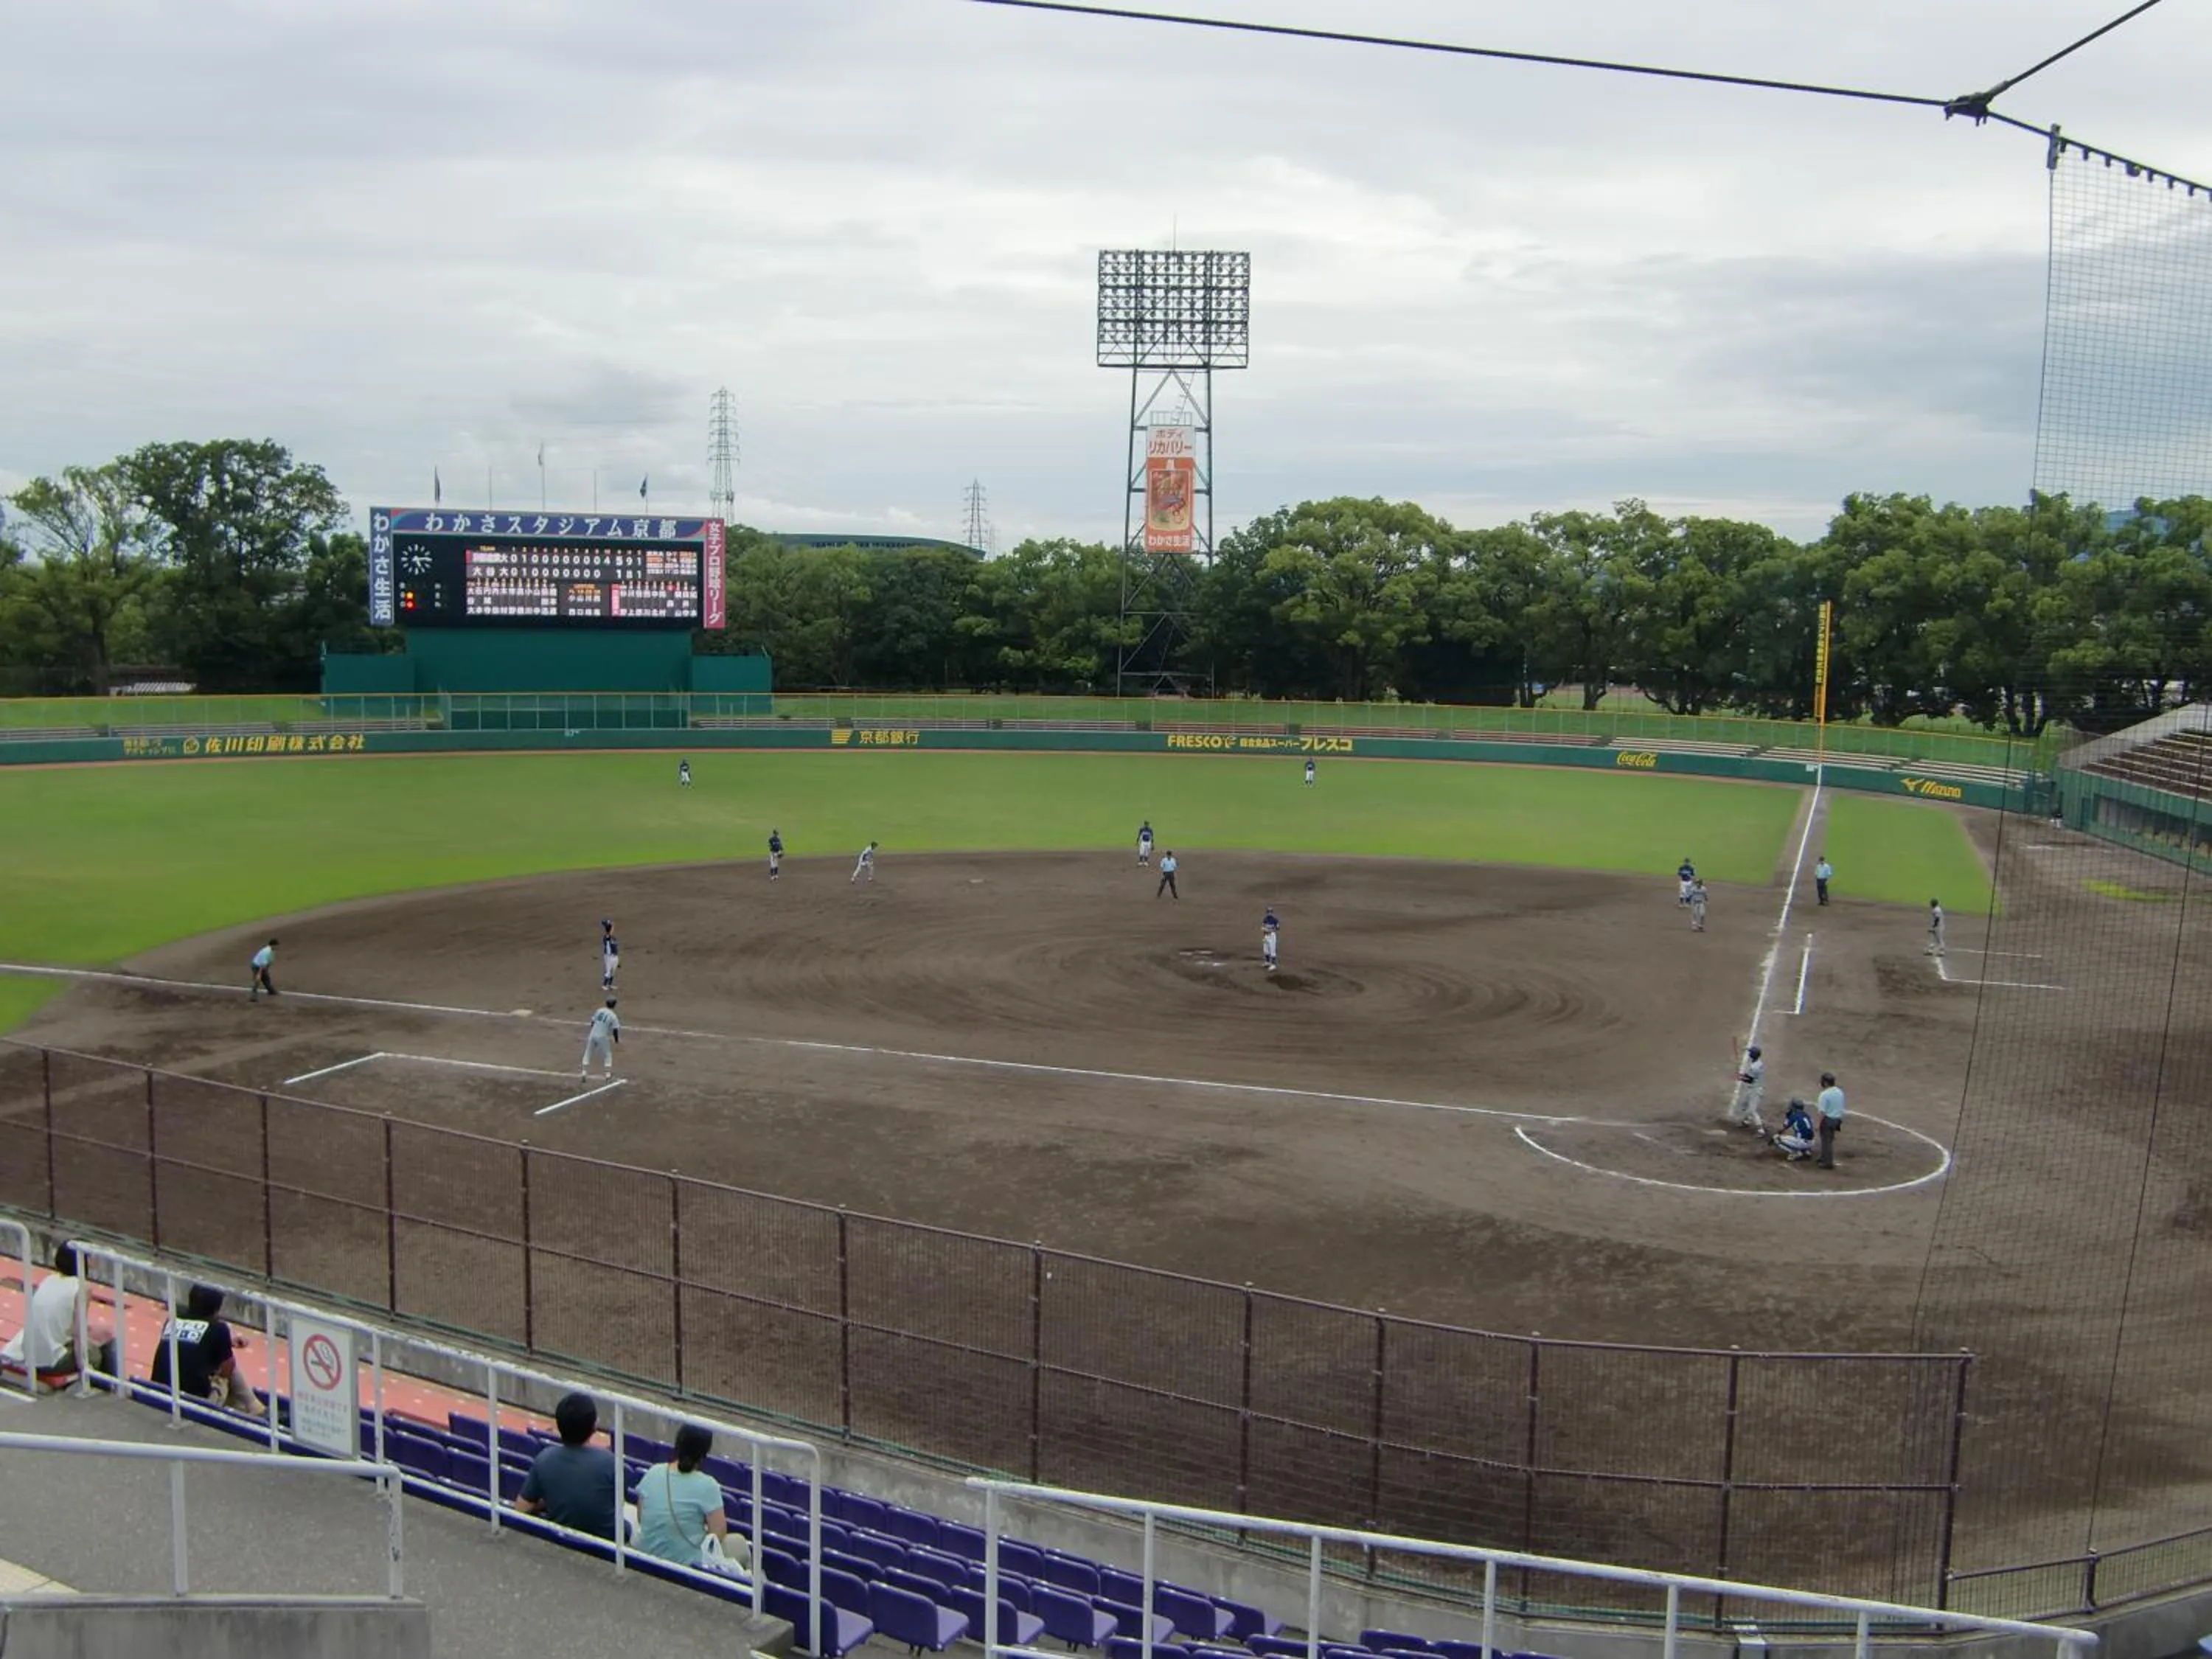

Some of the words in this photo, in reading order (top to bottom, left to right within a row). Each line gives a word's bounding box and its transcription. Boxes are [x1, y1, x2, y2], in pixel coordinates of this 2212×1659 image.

[1155, 428, 1183, 439] ボディ
[1150, 441, 1192, 454] リカバリー
[425, 513, 677, 539] わかさスタジアム京都
[374, 512, 392, 620] わかさ生活
[708, 521, 722, 625] 女子プロ野球リーグ
[206, 734, 365, 753] 佐川印刷株式会社
[859, 731, 919, 744] 京都銀行
[1168, 734, 1222, 748] FRESCO
[1300, 737, 1352, 751] フレスコ
